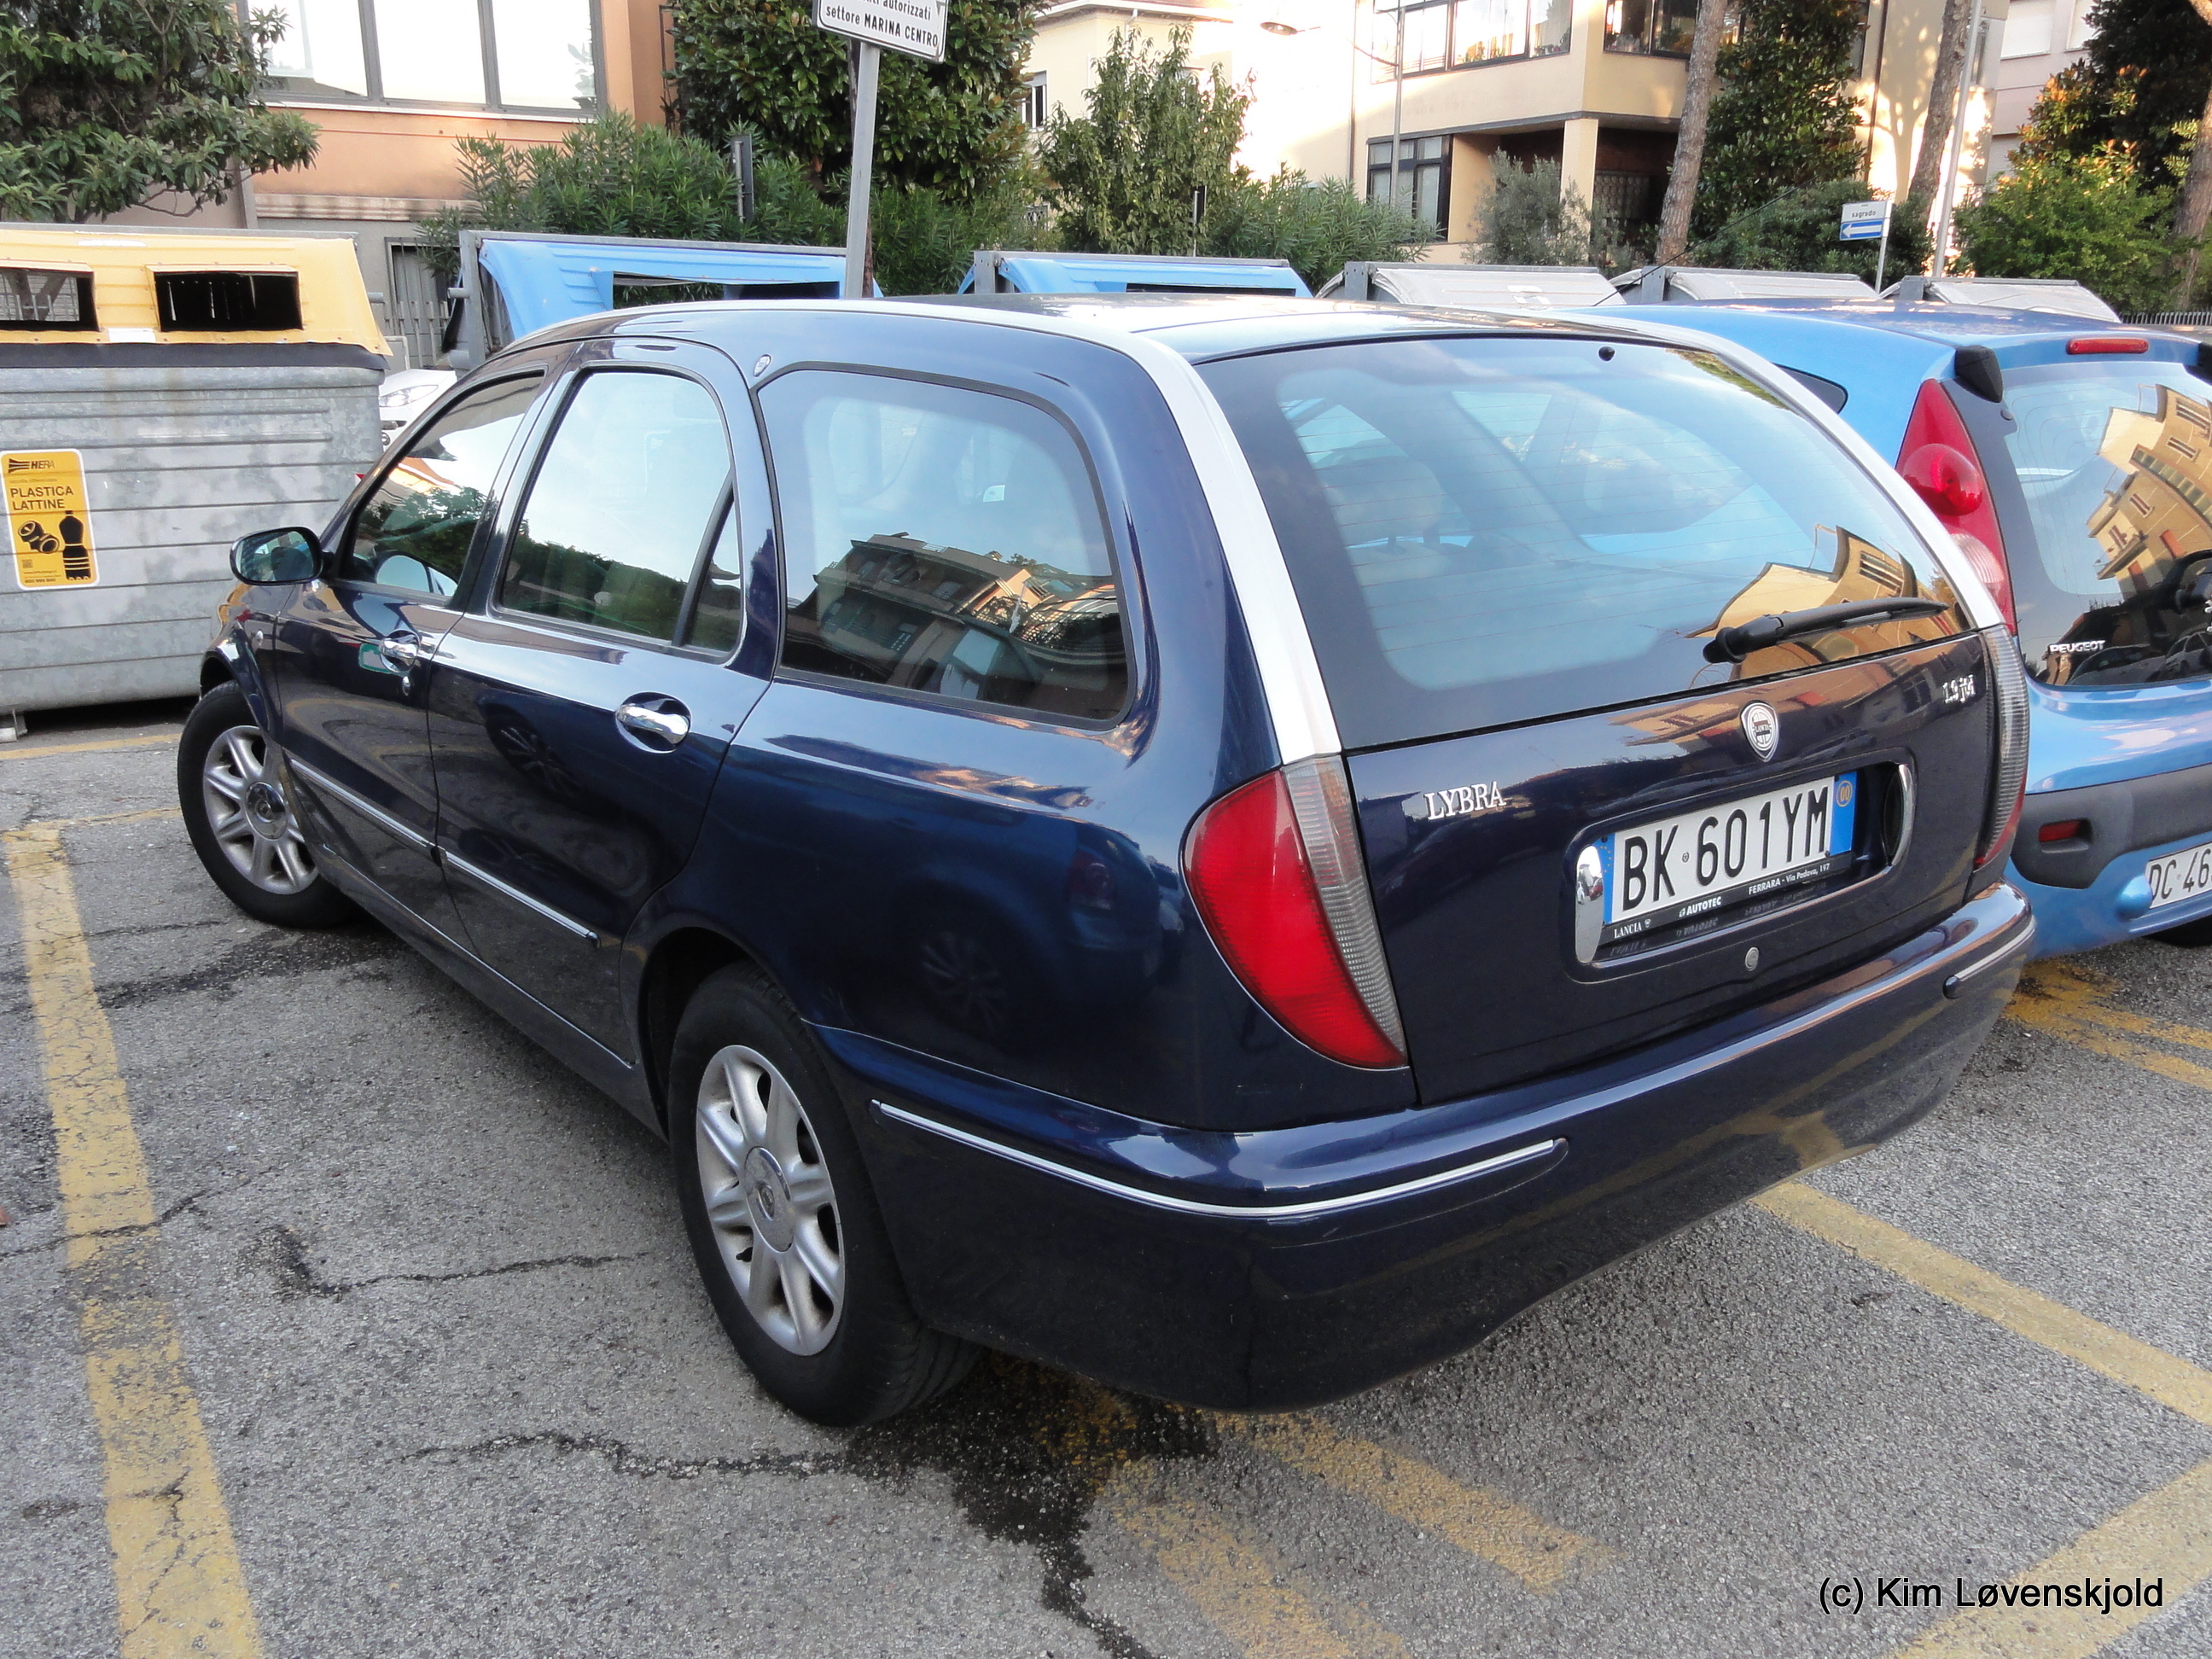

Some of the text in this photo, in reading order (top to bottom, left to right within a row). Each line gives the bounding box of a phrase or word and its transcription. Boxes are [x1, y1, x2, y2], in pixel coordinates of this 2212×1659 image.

[883, 0, 931, 20] autorizzati
[825, 5, 939, 47] settore MARINA CENTRO
[1851, 210, 1876, 218] sagrado
[31, 460, 55, 469] HERA
[10, 486, 74, 498] PLASTICA
[13, 499, 65, 510] LATTINE
[2049, 640, 2106, 653] PEUGEOT
[1423, 781, 1506, 820] LYBRA
[1622, 824, 1679, 911] BK
[2149, 848, 2212, 899] DC 46
[1749, 878, 1781, 894] FERRARA
[1786, 874, 1796, 883] Via
[1686, 896, 1721, 916] AUTOTEC
[1614, 922, 1642, 939] LANCIA
